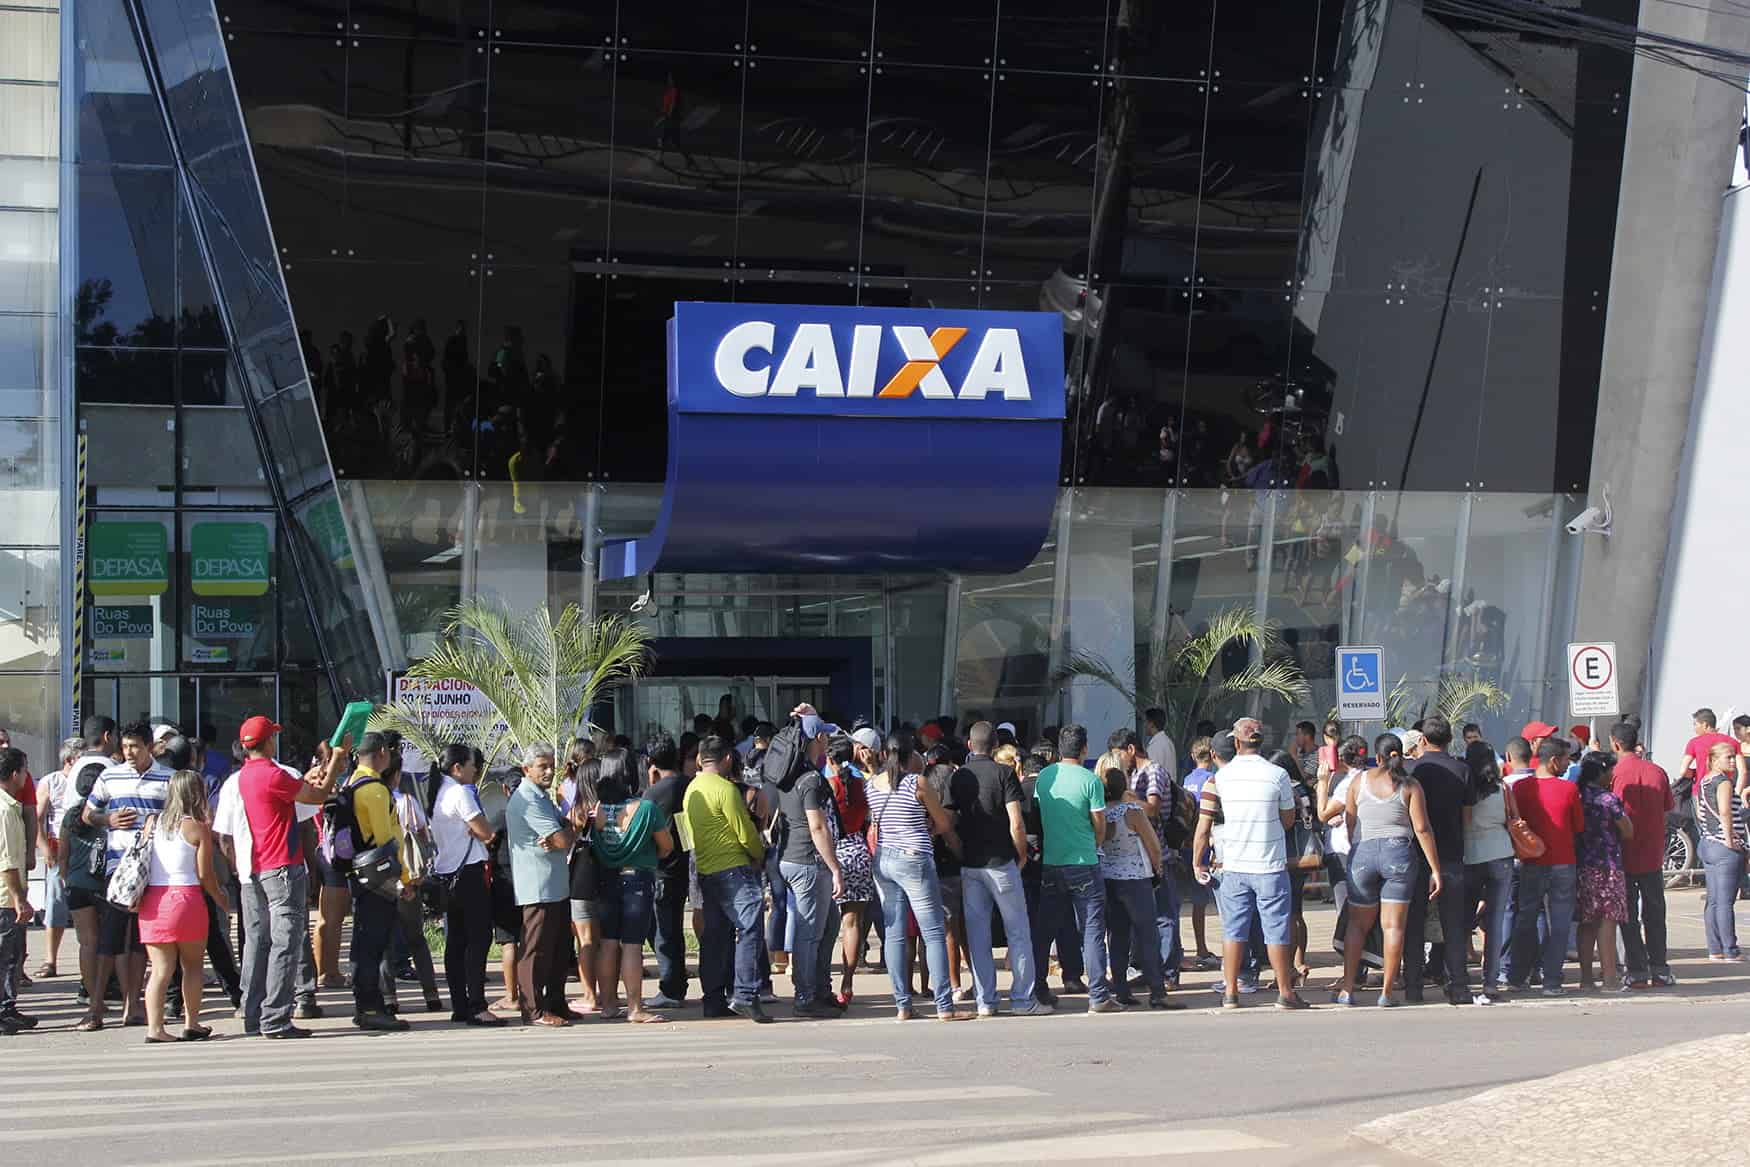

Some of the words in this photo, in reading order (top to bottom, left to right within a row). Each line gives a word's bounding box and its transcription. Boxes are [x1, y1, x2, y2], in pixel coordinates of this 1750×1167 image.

[714, 320, 1032, 401] CAIXA
[93, 558, 165, 576] DEPASA
[195, 558, 265, 576] DEPASA
[95, 607, 129, 620] Ruas
[196, 606, 231, 619] Ruas
[95, 621, 114, 633] Do
[118, 621, 153, 633] Povo
[196, 620, 215, 633] Do
[219, 620, 253, 633] Povo
[1586, 657, 1600, 679] E
[434, 693, 471, 705] JUNHO
